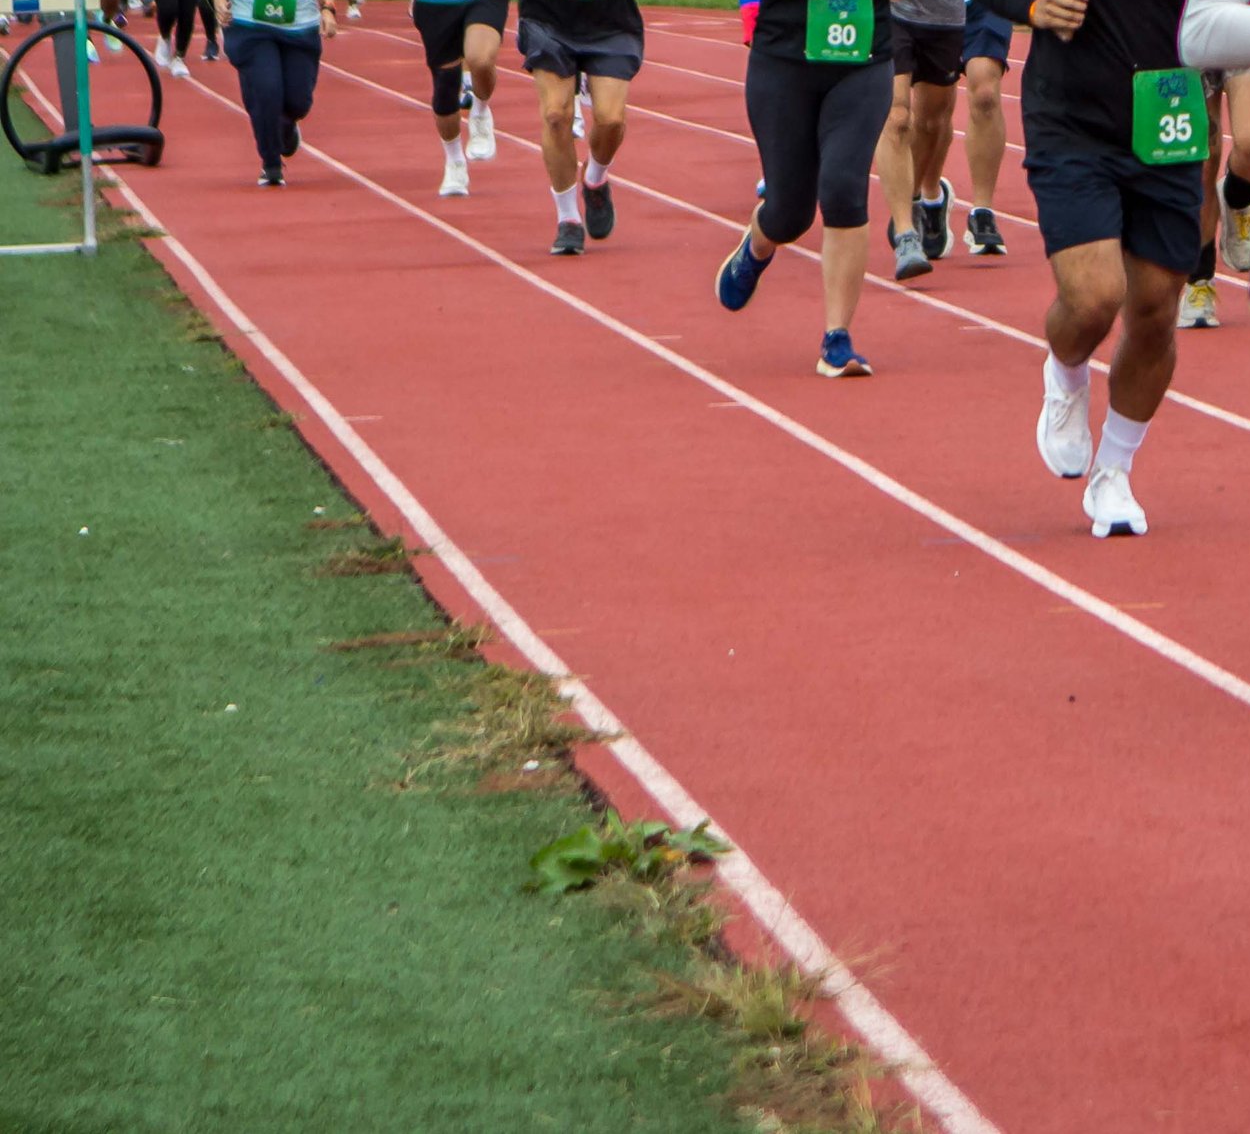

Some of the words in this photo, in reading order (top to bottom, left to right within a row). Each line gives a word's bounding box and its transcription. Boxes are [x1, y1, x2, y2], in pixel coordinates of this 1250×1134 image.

[264, 3, 284, 17] 34
[827, 24, 857, 46] 80
[1160, 113, 1192, 143] 35
